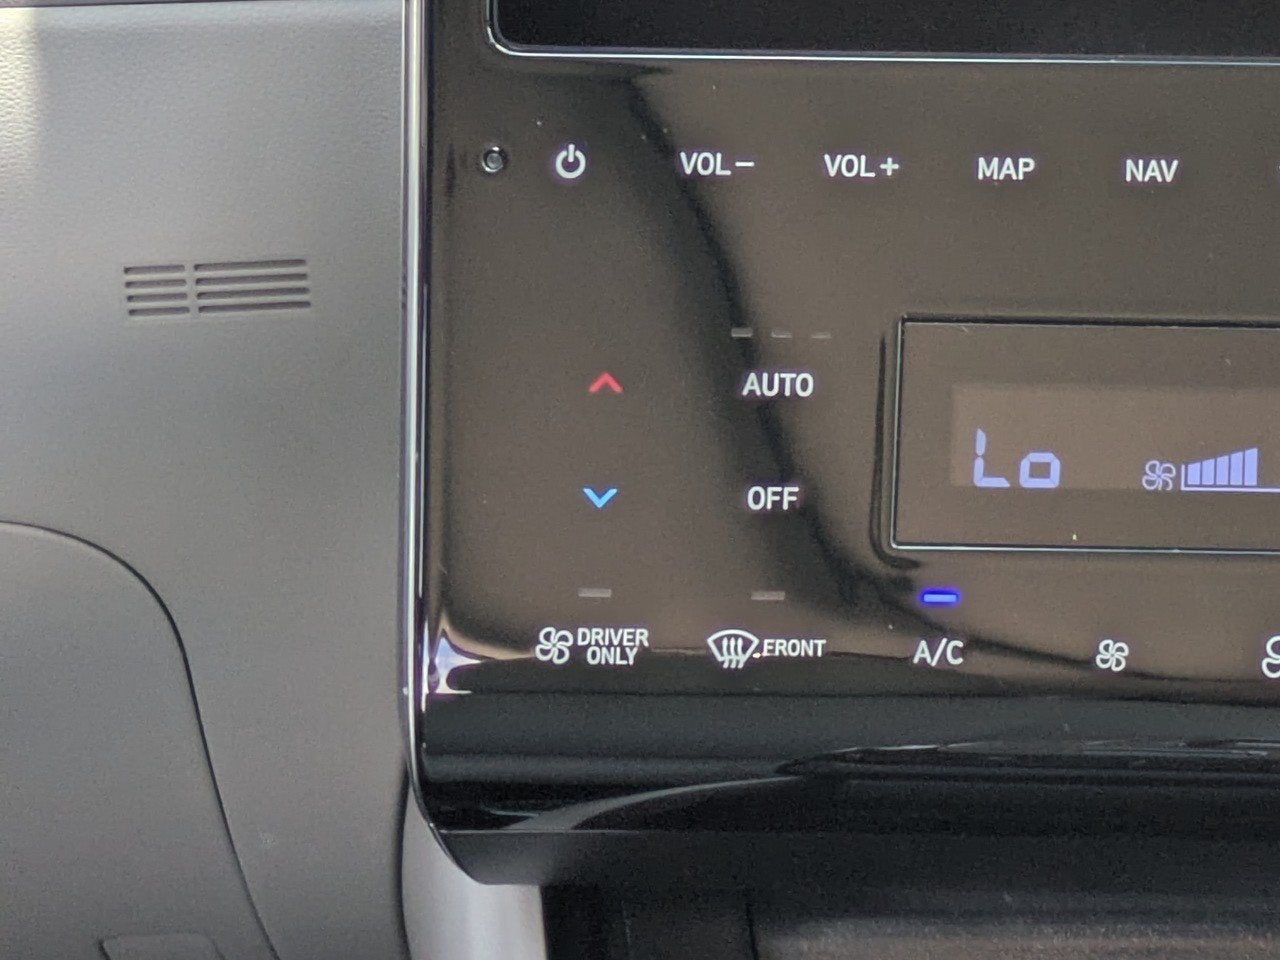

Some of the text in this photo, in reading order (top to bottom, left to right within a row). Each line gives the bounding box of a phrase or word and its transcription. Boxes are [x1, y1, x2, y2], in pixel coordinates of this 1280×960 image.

[977, 156, 1036, 181] MAP
[1125, 159, 1178, 184] NAV
[742, 372, 815, 397] AUTO
[747, 485, 800, 511] OFF
[576, 628, 649, 648] DRIVER
[763, 639, 827, 658] FRONT
[586, 645, 638, 667] ONLY
[913, 639, 964, 666] A/C
